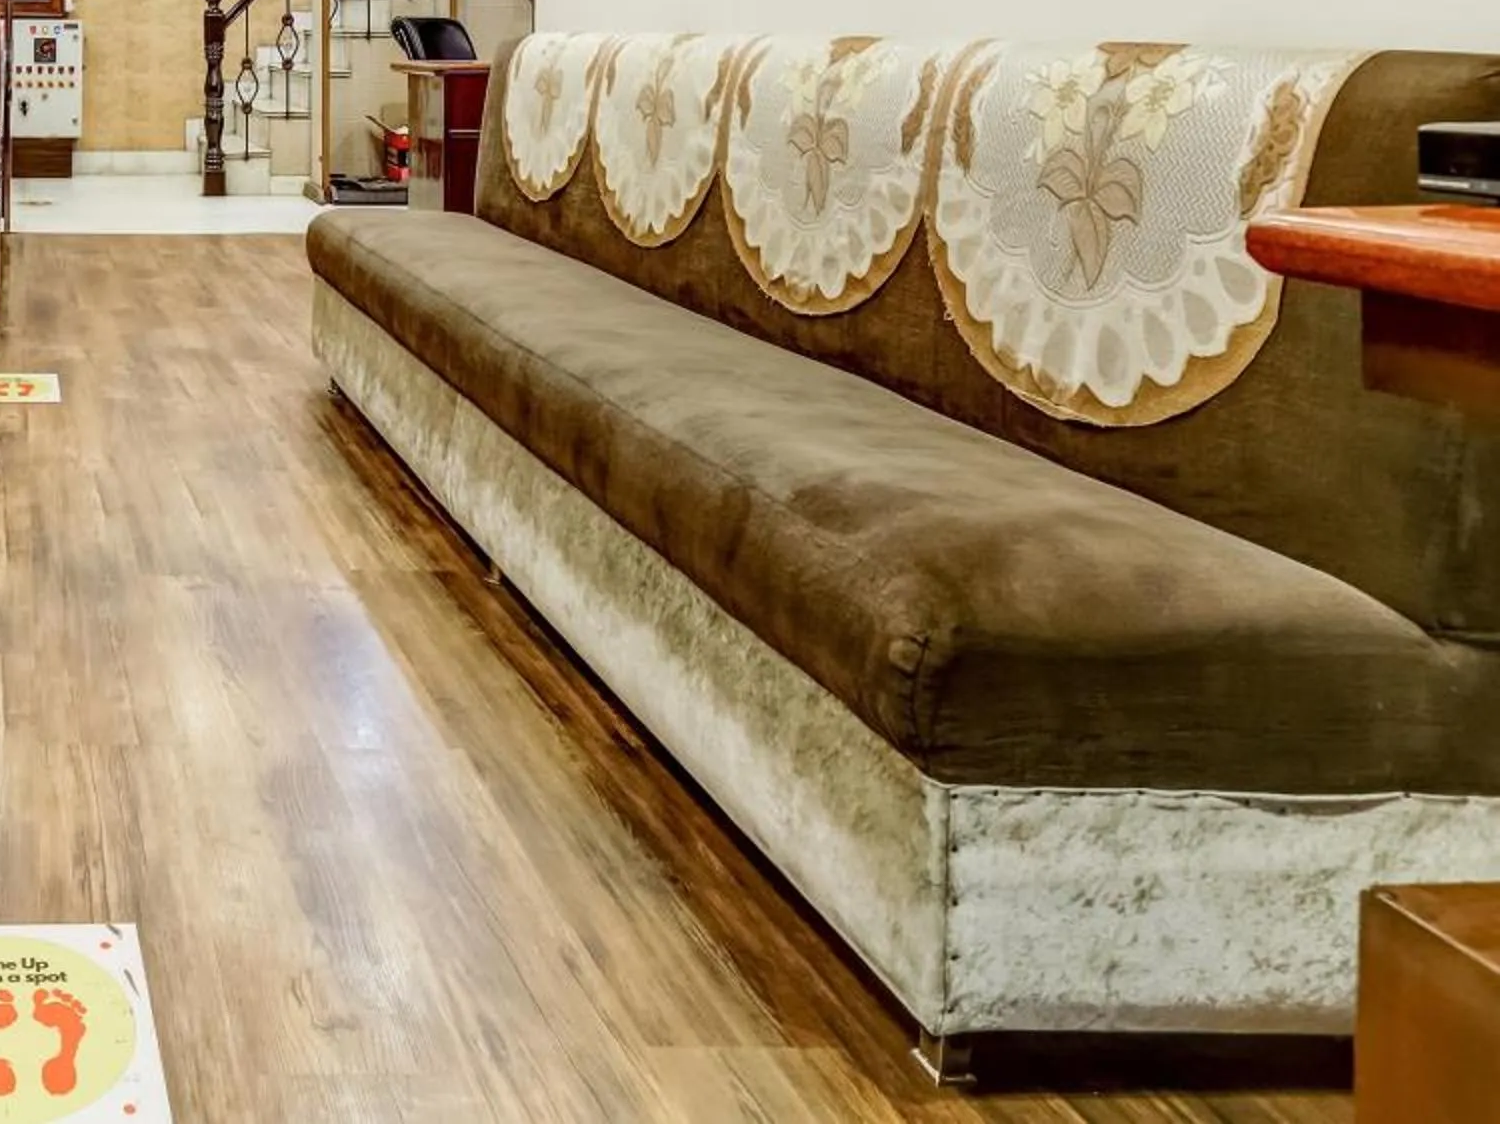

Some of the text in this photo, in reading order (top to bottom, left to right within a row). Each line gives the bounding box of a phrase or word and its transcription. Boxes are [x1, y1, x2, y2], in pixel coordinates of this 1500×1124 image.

[21, 957, 49, 972] Up
[7, 975, 20, 983] a
[25, 972, 67, 986] spot
